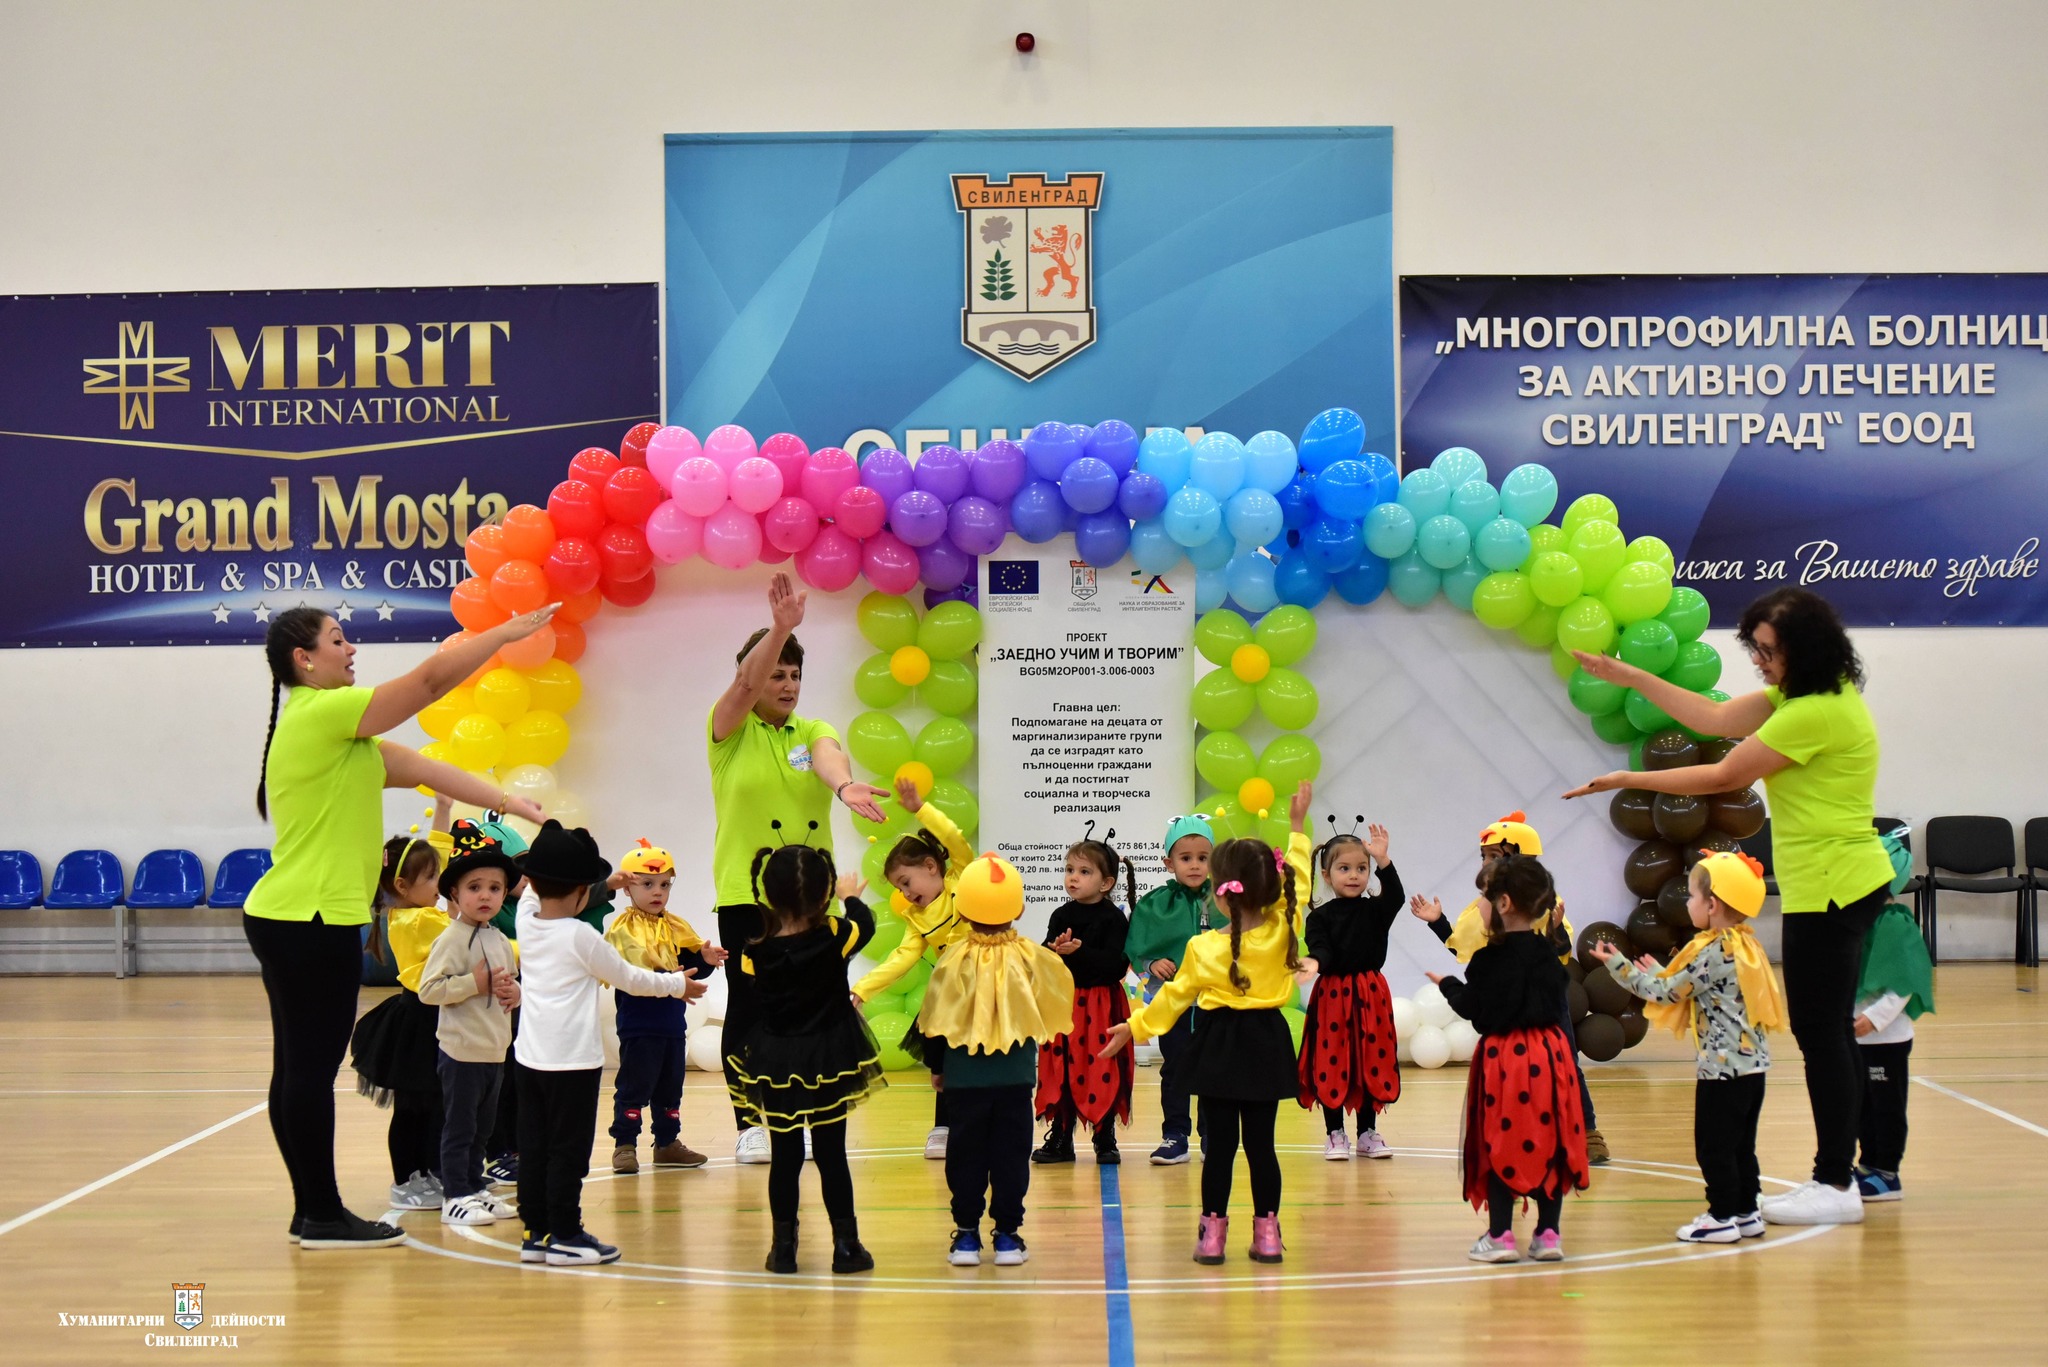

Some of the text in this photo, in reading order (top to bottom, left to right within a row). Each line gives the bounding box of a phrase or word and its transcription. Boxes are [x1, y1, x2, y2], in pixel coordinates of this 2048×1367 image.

[968, 190, 1088, 204] СВИЛЕНГРАД
[1518, 363, 1996, 397] ЗА АКТИВНО ЛЕЧЕНИЕ
[207, 396, 511, 427] INTERNATIONAL
[1858, 411, 1975, 449] ЕООД
[84, 476, 294, 554] Grand
[1675, 537, 2040, 598] ижа за Вашето здраве
[88, 558, 478, 593] HOTEL & SPA & CASI
[1066, 633, 1108, 642] ПРОЕКТ
[1060, 648, 1100, 659] УЧИМ
[1104, 648, 1114, 659] И
[1053, 703, 1121, 713] Главна цел:
[1011, 718, 1088, 728] Подпомагане
[1107, 719, 1147, 728] децата
[1012, 732, 1162, 742] маргинализираните групи
[1031, 748, 1045, 756] да
[1064, 748, 1115, 757] изградят
[1118, 747, 1144, 755] като
[1022, 762, 1152, 771] пълноценни граждани
[1045, 776, 1130, 785] и да постигнат
[1024, 790, 1151, 800] социална и творческа
[1053, 804, 1121, 815] реализация
[998, 842, 1022, 851] Обща
[1024, 842, 1063, 850] стойност
[1117, 842, 1131, 850] 275
[1133, 842, 1160, 851] 861,34
[1025, 895, 1046, 904] Край
